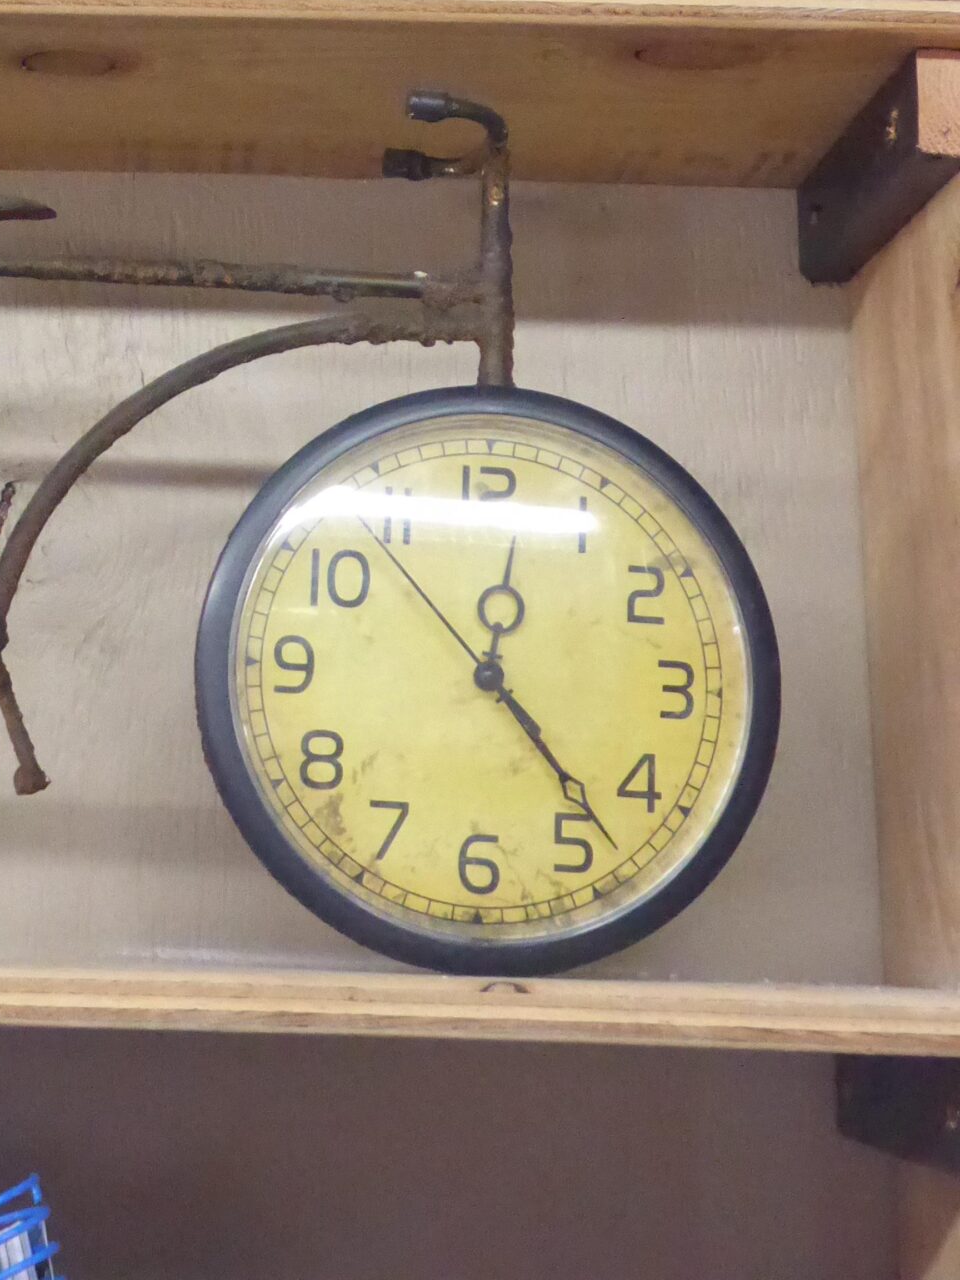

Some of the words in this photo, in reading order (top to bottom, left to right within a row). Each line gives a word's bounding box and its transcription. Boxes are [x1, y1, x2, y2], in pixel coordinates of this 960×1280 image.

[461, 464, 517, 501] 12
[577, 495, 588, 554] 1
[310, 547, 371, 609] 10
[626, 564, 666, 625] 2
[273, 635, 315, 694] 9
[658, 659, 696, 720] 3
[298, 729, 344, 790] 8
[616, 753, 662, 813] 4
[369, 799, 410, 861] 7
[553, 812, 594, 873] 5
[458, 834, 501, 894] 6
